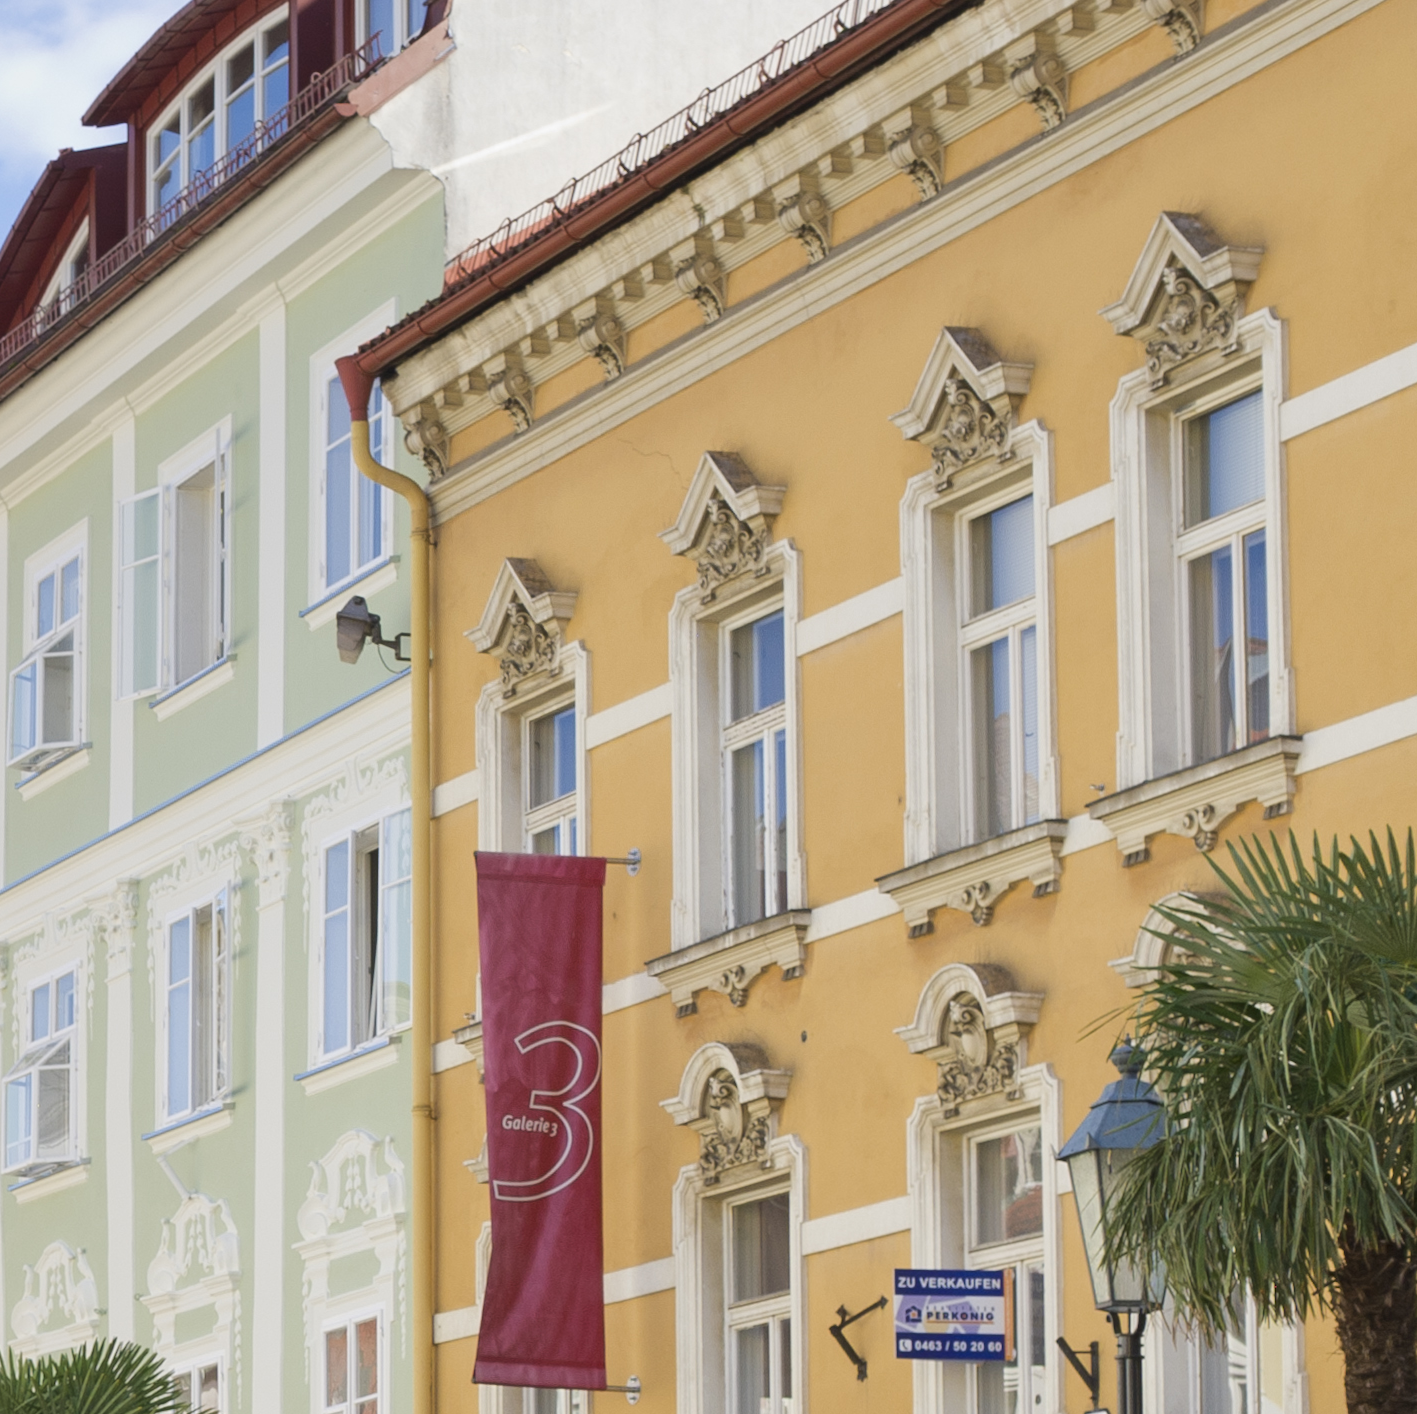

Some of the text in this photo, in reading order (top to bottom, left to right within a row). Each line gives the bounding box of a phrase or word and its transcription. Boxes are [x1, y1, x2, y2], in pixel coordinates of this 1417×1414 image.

[492, 1020, 602, 1202] 3
[502, 1114, 559, 1138] Galerie 3
[897, 1276, 1001, 1290] ZU VERKAUFEN
[926, 1311, 994, 1321] PERKONIG
[914, 1340, 943, 1352] 0463
[952, 1341, 967, 1352] 50
[970, 1341, 985, 1352] 20
[987, 1342, 1002, 1352] 60
